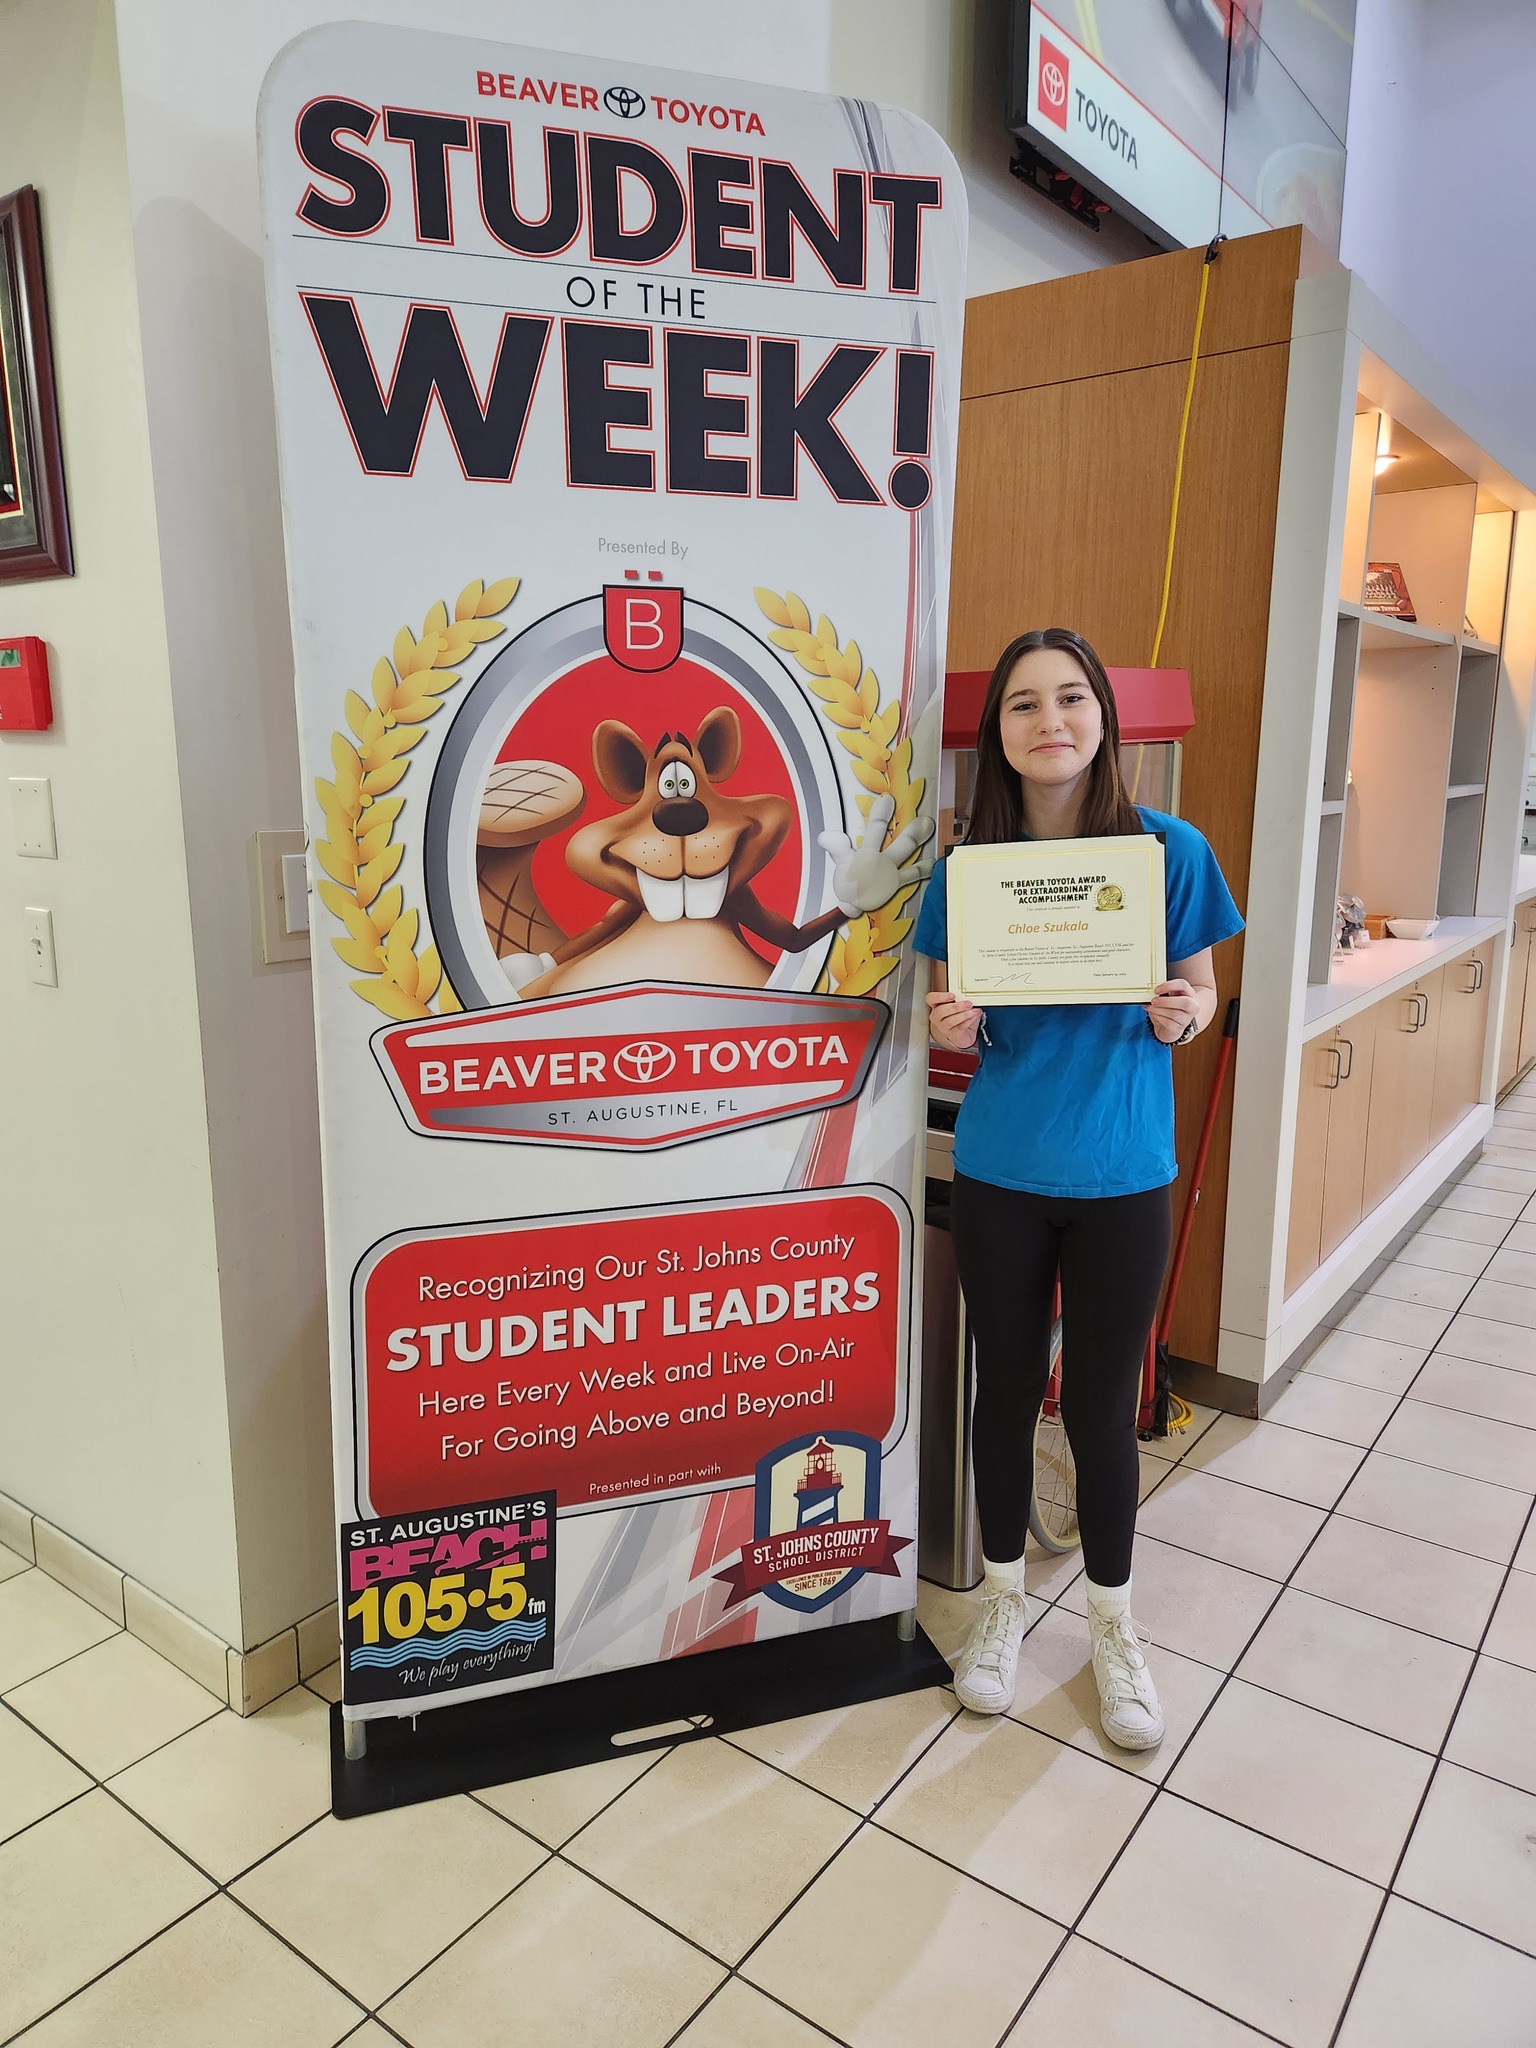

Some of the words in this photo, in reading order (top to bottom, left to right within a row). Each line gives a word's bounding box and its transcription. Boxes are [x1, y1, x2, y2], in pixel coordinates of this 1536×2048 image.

[475, 71, 599, 112] BEAVER
[650, 95, 766, 137] TOYOTA
[1075, 87, 1138, 170] TOYOTA
[295, 94, 943, 295] STUDENT
[565, 276, 619, 310] OF
[640, 283, 706, 319] THE
[299, 292, 935, 511] WEEK!
[598, 537, 666, 555] Presented
[671, 541, 689, 560] By
[1001, 881, 1014, 889] THE
[1016, 879, 1045, 888] BEAVER
[1047, 877, 1076, 886] TOYOTA
[1078, 875, 1107, 884] AWARD
[1013, 888, 1028, 896] FOR
[1030, 885, 1093, 895] EXTRAORDINARY
[1019, 893, 1089, 904] ACCOMPLISHMENT
[1008, 923, 1041, 934] Chloe
[1043, 920, 1089, 933] Szukala
[418, 1050, 607, 1095] BEAVER
[684, 1035, 850, 1075] TOYOTA
[548, 1112, 577, 1126] ST.
[587, 1101, 707, 1124] AUGUSTINE,
[717, 1099, 739, 1113] FL
[418, 1263, 585, 1302] Recognizing
[595, 1255, 648, 1281] Our
[656, 1249, 685, 1274] St.
[692, 1240, 762, 1272] Johns
[770, 1233, 855, 1260] County
[386, 1299, 647, 1372] STUDENT
[662, 1271, 881, 1337] LEADERS
[418, 1390, 486, 1418] Here
[497, 1380, 571, 1406] Every
[579, 1360, 656, 1395] Week
[664, 1352, 713, 1383] and
[723, 1351, 766, 1375] Live
[775, 1337, 855, 1367] On-Air
[441, 1435, 484, 1461] For
[493, 1423, 577, 1451] Going
[586, 1409, 670, 1439] Above
[679, 1393, 727, 1425] and
[736, 1378, 834, 1418] Beyond!
[589, 1473, 650, 1495] Presented
[653, 1472, 664, 1484] in
[668, 1470, 693, 1485] part
[696, 1462, 722, 1477] with
[350, 1527, 384, 1547] ST.
[389, 1500, 547, 1541] AUGUSTINE'S
[753, 1545, 775, 1565] ST.
[776, 1533, 822, 1558] JOHNS
[824, 1527, 880, 1548] COUNTY
[349, 1518, 548, 1592] BEACH
[768, 1554, 811, 1573] SCHOOL
[815, 1546, 865, 1562] DISTRICT
[528, 1597, 546, 1615] fm
[794, 1579, 817, 1592] SINCE
[819, 1576, 837, 1587] 1869
[398, 1667, 426, 1685] We
[428, 1656, 460, 1687] play
[463, 1636, 539, 1672] everything!
